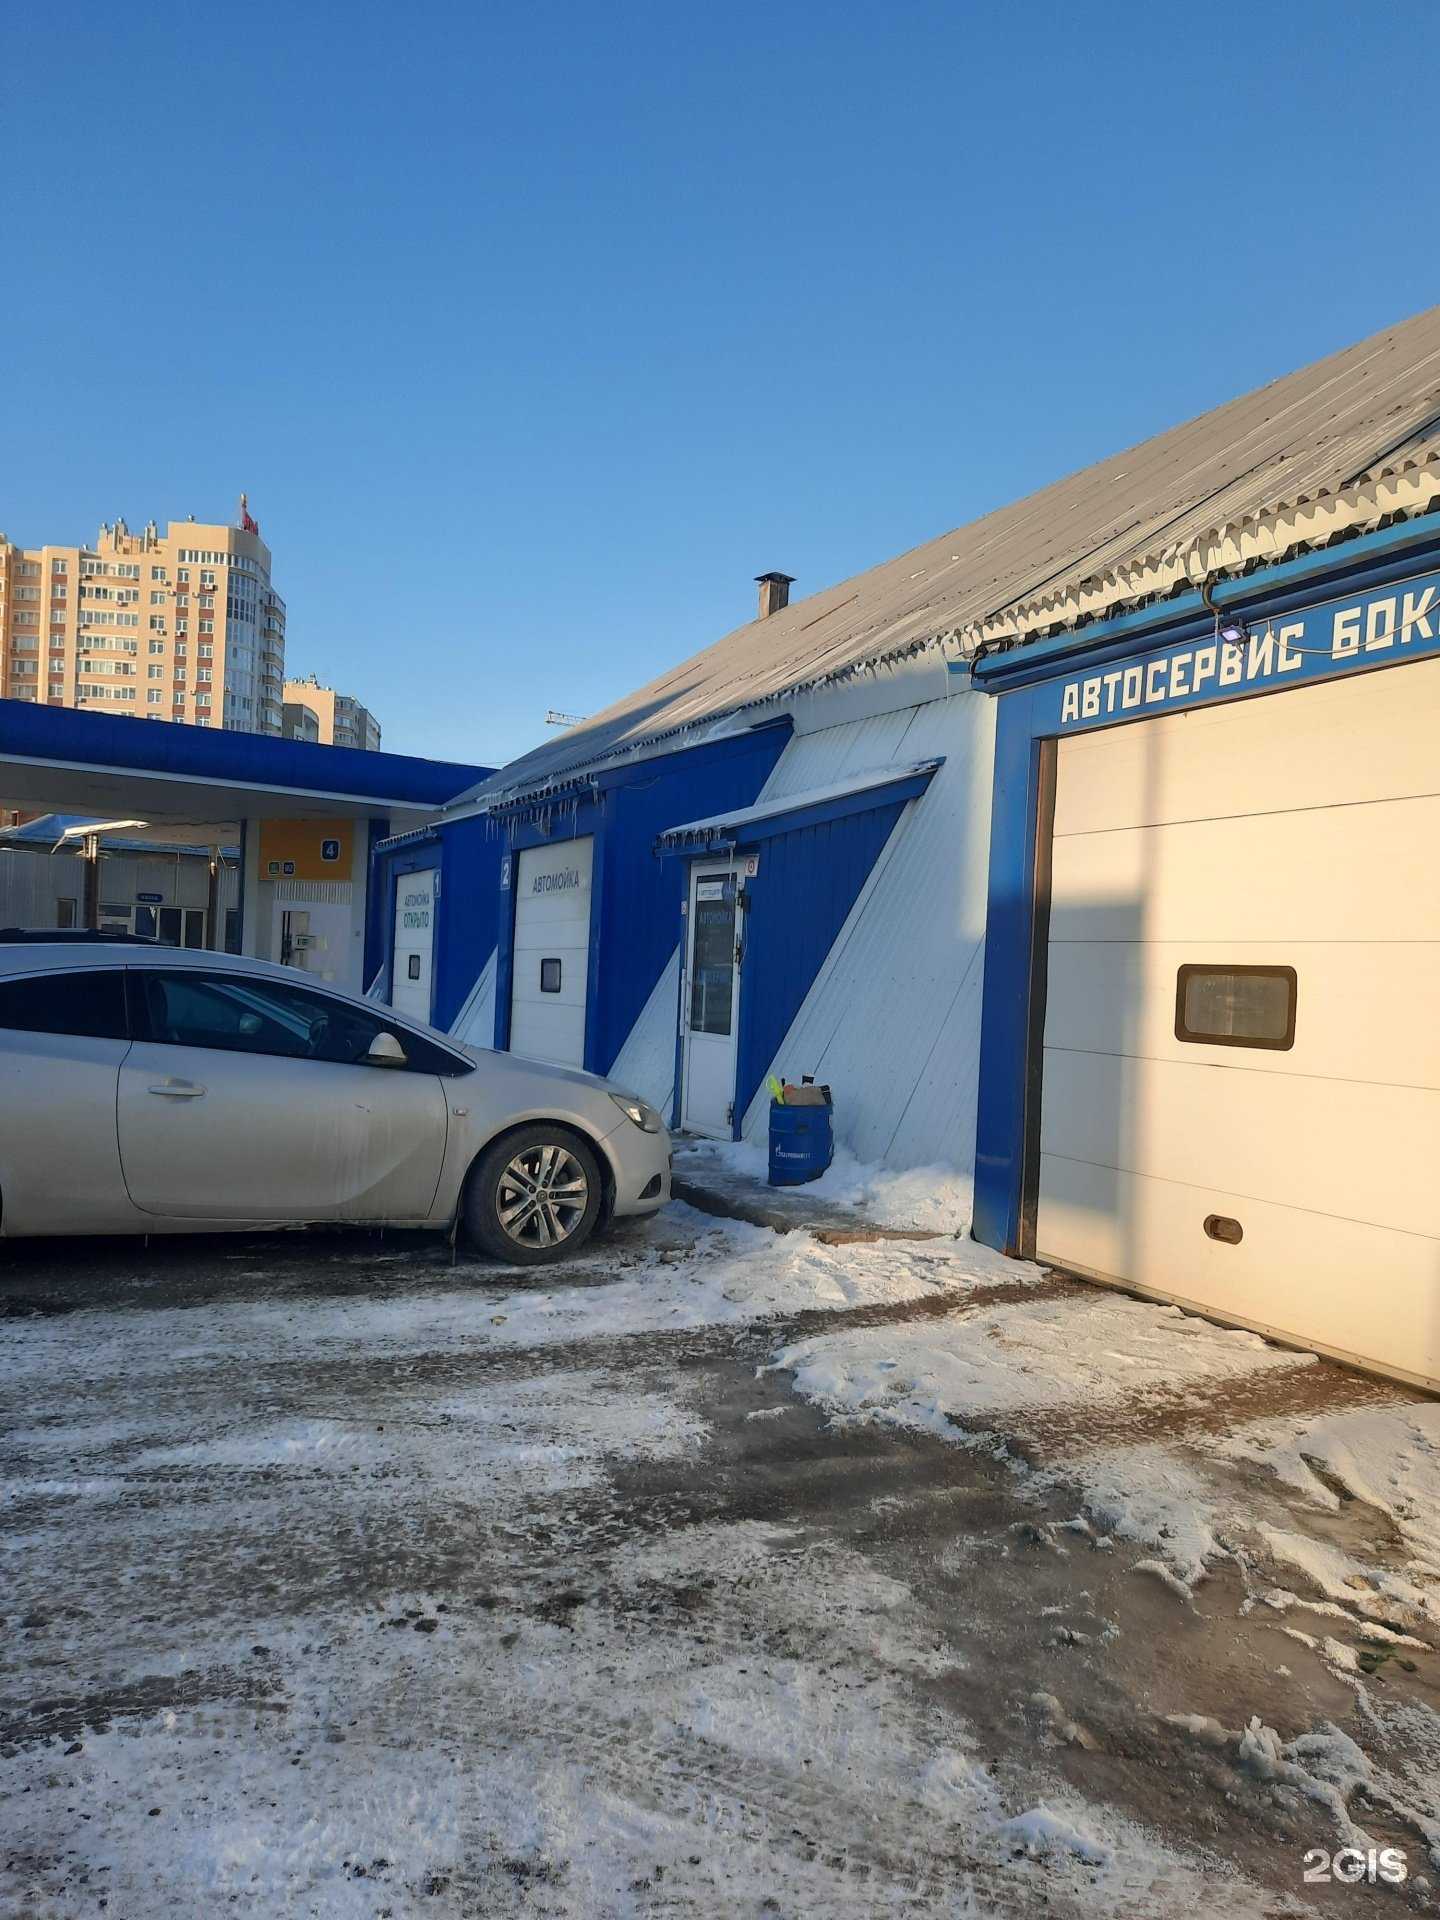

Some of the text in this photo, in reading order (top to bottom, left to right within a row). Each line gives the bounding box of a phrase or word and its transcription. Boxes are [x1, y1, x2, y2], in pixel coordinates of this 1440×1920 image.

[1061, 586, 1440, 724] АВТОСЕРВИС БОК
[502, 862, 510, 885] 2
[532, 866, 580, 893] АВТОМОЙКА
[404, 890, 430, 907] АВТОМОЙКА
[403, 911, 430, 928] ОТКРЫТО
